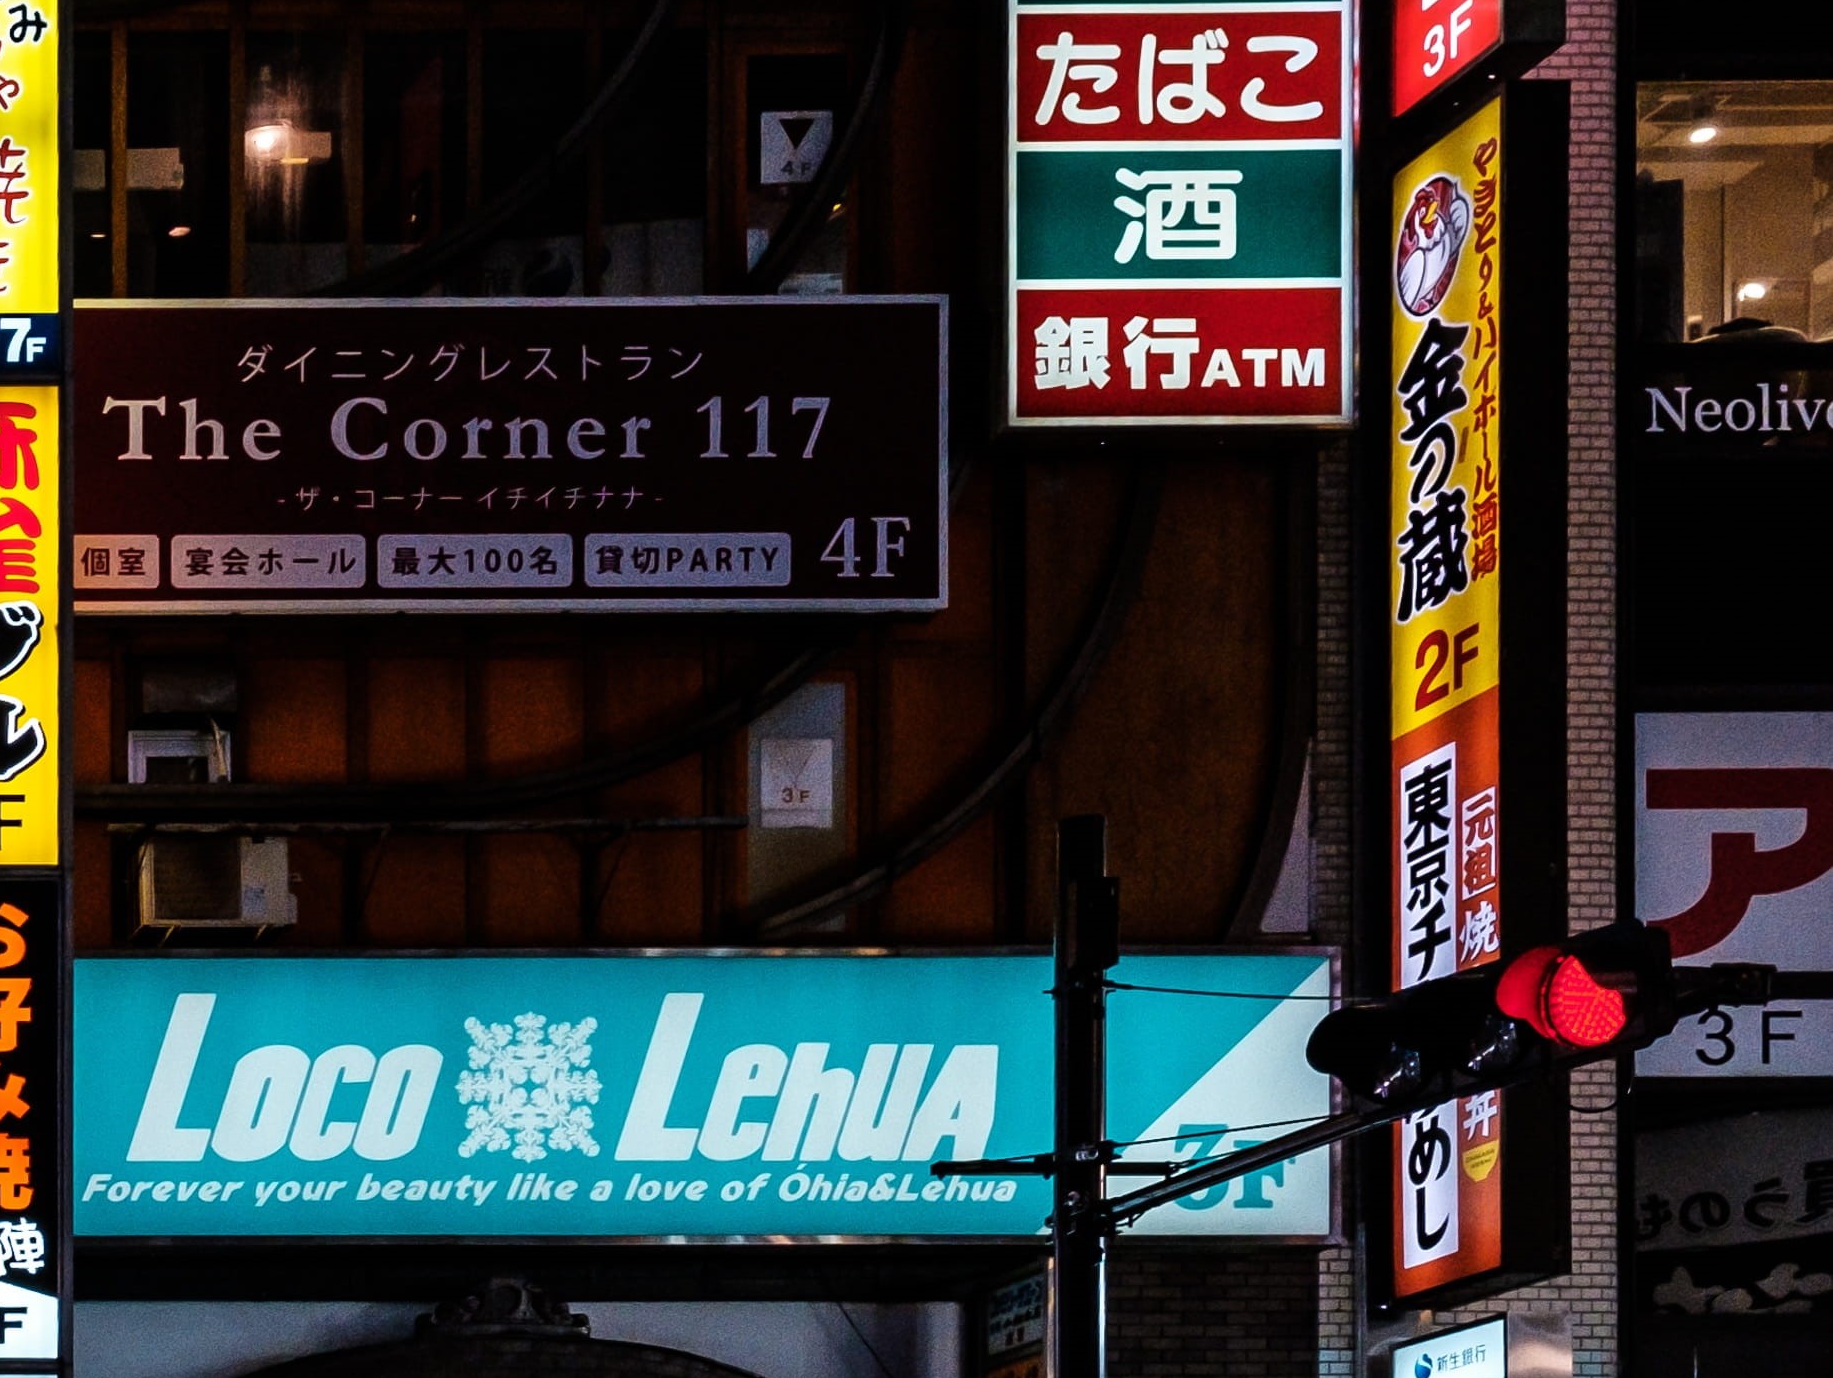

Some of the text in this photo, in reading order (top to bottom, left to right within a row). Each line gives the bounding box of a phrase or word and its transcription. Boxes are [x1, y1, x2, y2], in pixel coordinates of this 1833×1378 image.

[1035, 28, 1324, 127] たばこ
[1114, 166, 1245, 266] 酒
[0, 318, 47, 363] 7F
[236, 343, 706, 383] ダイニングレストラン
[102, 395, 832, 462] The Corner 117
[1395, 318, 1471, 623] 金の蔵
[80, 516, 912, 580] 個室 宴会ホール 最大100名 貸切PARTY 4F
[1414, 622, 1481, 712] 2F
[82, 1173, 247, 1204] Forever
[256, 1179, 343, 1208] your
[355, 1173, 495, 1208] beauty
[506, 1173, 578, 1204] like
[589, 1180, 613, 1204] a
[623, 1173, 709, 1204] love
[720, 1173, 765, 1204] of
[1436, 1343, 1487, 1373] 新生銀行
